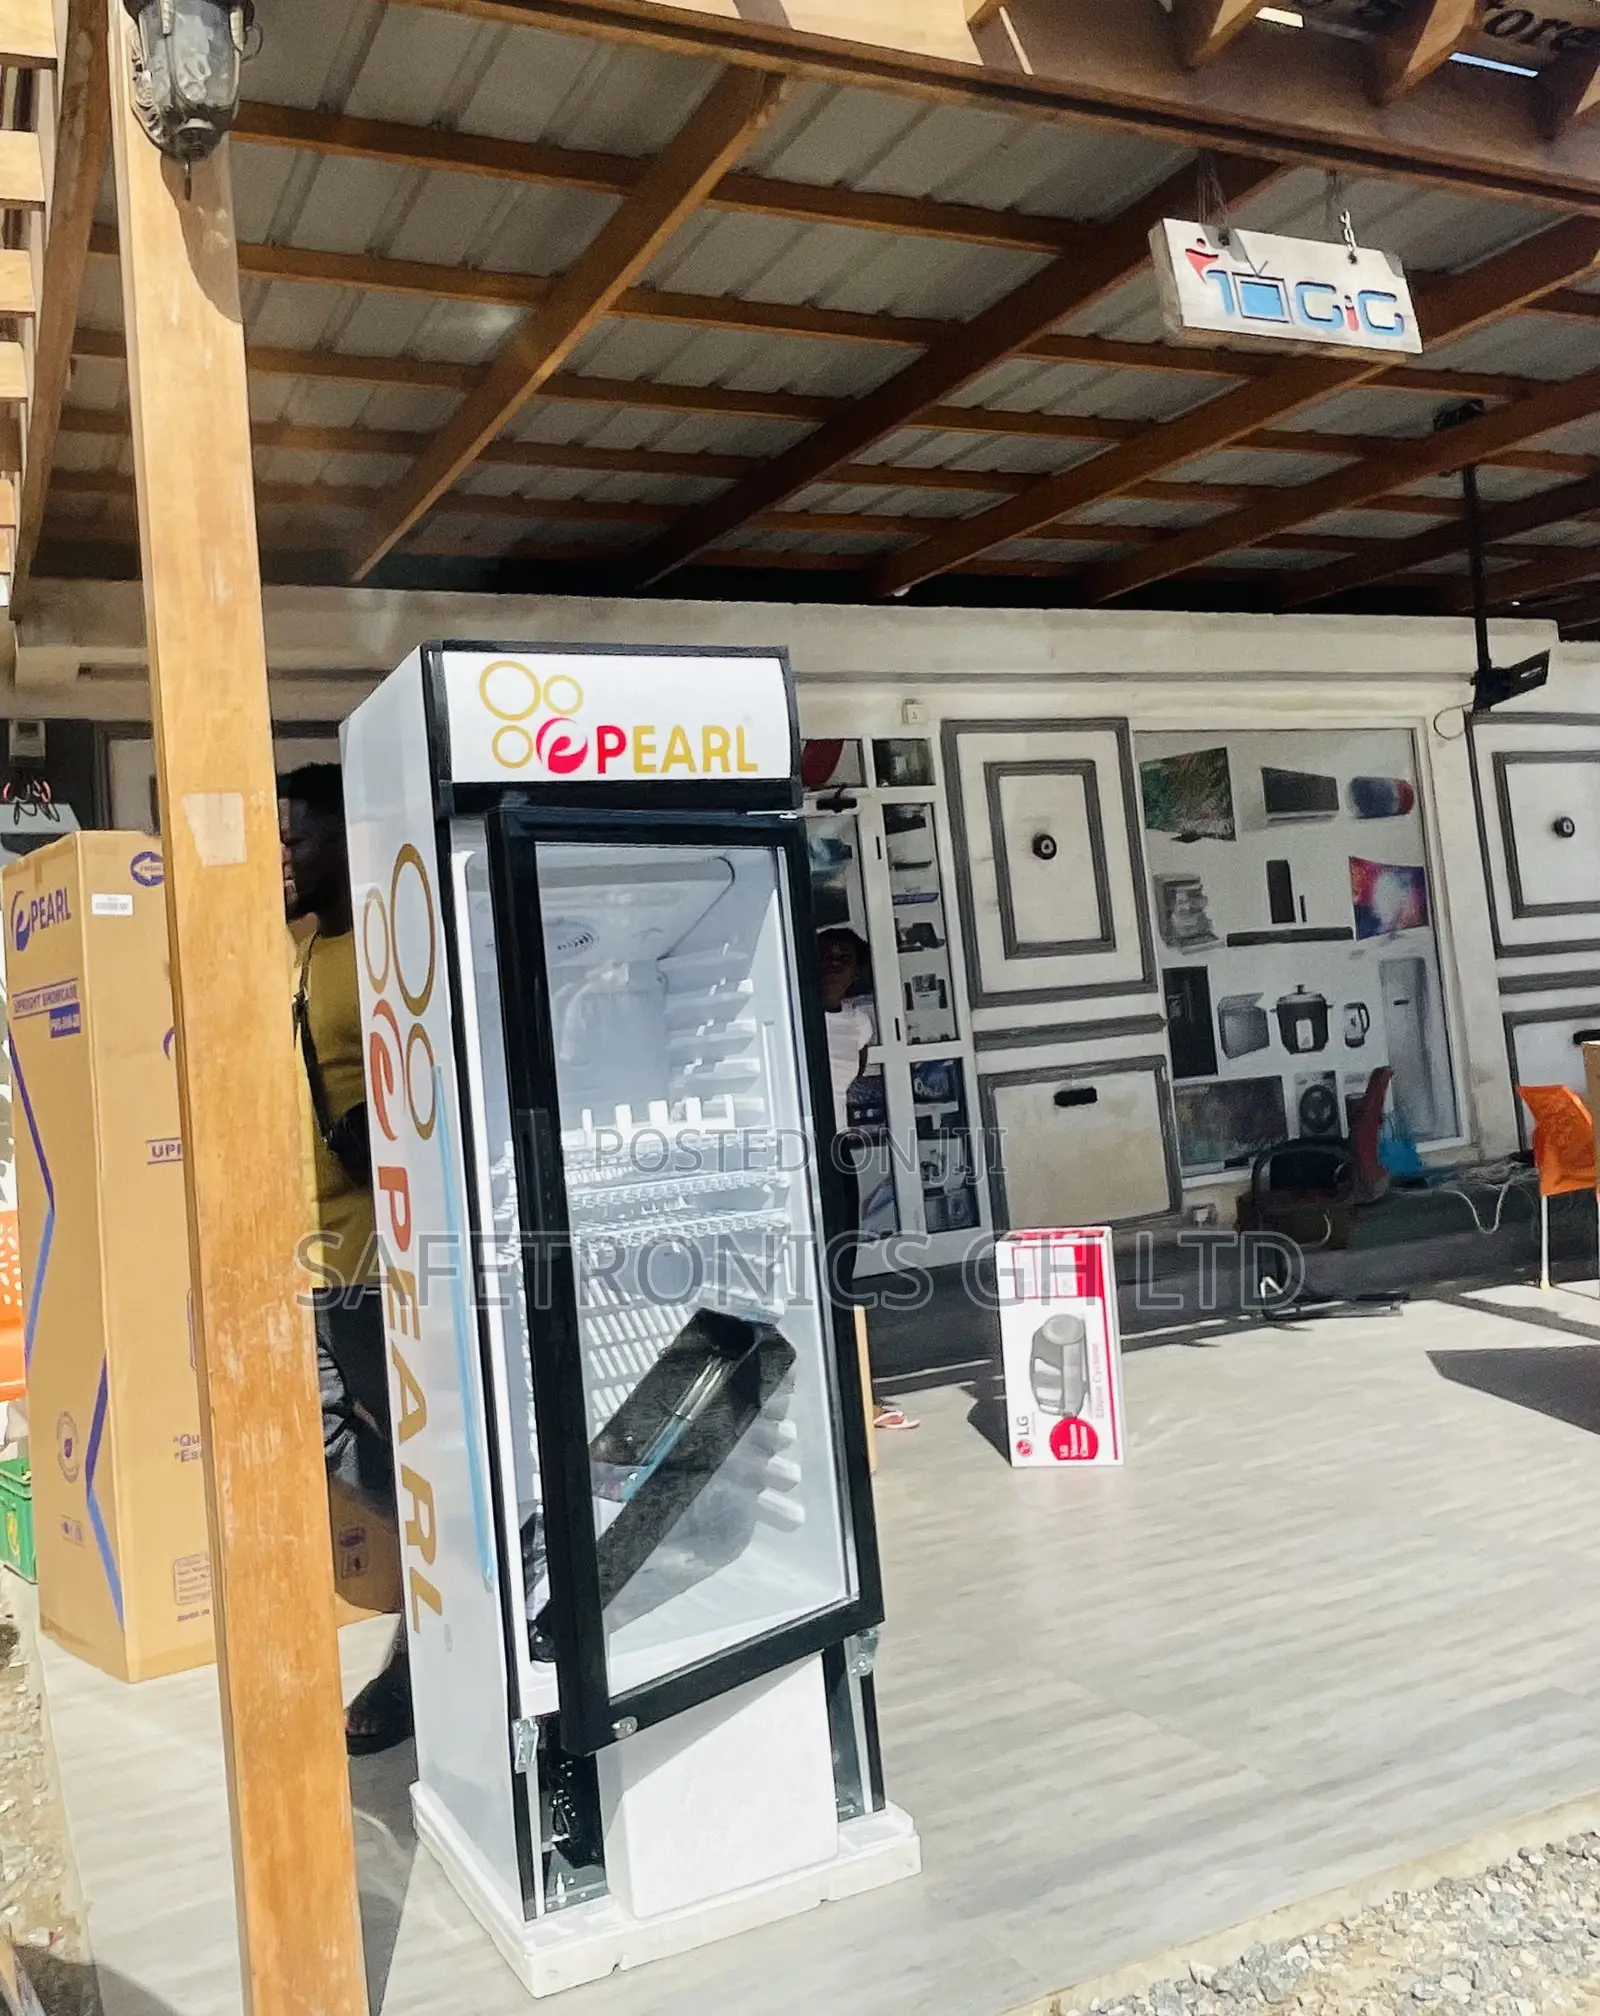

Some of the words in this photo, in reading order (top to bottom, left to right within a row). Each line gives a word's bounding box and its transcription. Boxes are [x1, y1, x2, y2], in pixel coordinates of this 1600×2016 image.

[596, 725, 758, 774] PEARL
[30, 886, 71, 933] PEARL
[378, 1165, 443, 1634] PEARL
[1016, 1416, 1029, 1436] LG
